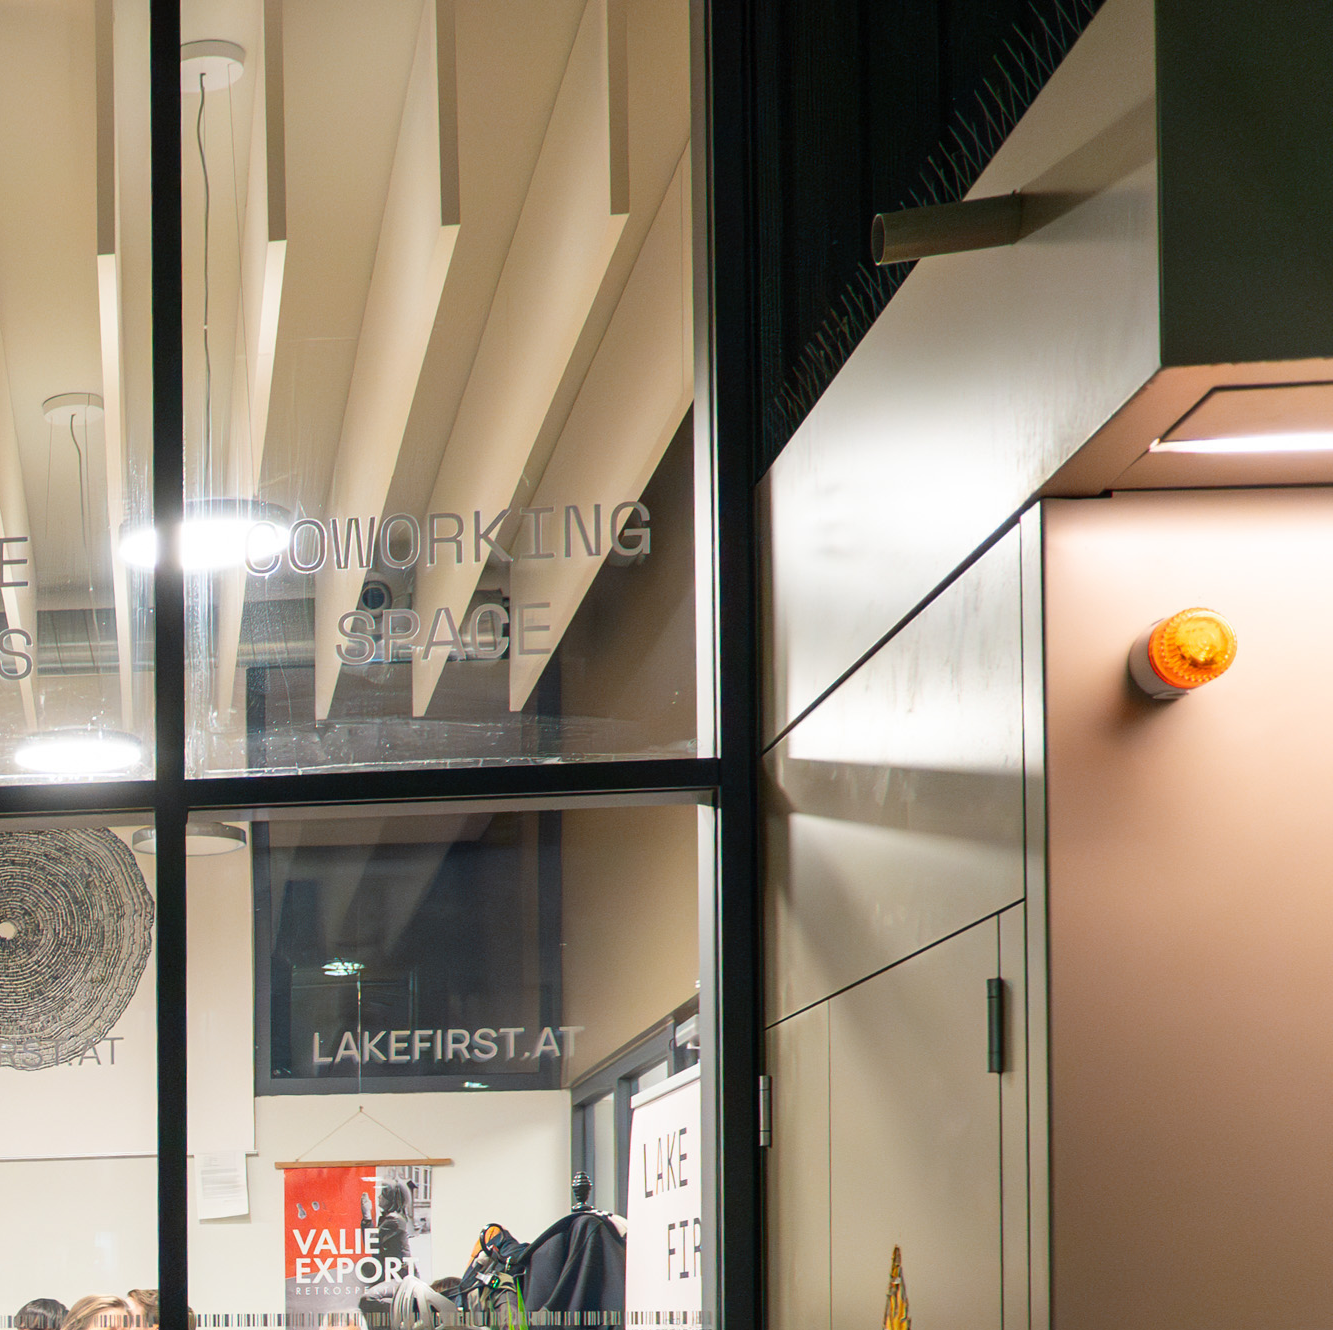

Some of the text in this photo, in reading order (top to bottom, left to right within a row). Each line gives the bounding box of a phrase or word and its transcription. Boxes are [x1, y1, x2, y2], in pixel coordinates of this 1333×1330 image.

[244, 500, 652, 577] COWORKING
[335, 601, 552, 666] SPACE
[313, 1026, 585, 1063] LAKEFIRST.AT
[643, 1127, 688, 1198] LAKE
[292, 1228, 380, 1255] VALIE
[295, 1256, 420, 1284] EXPORT
